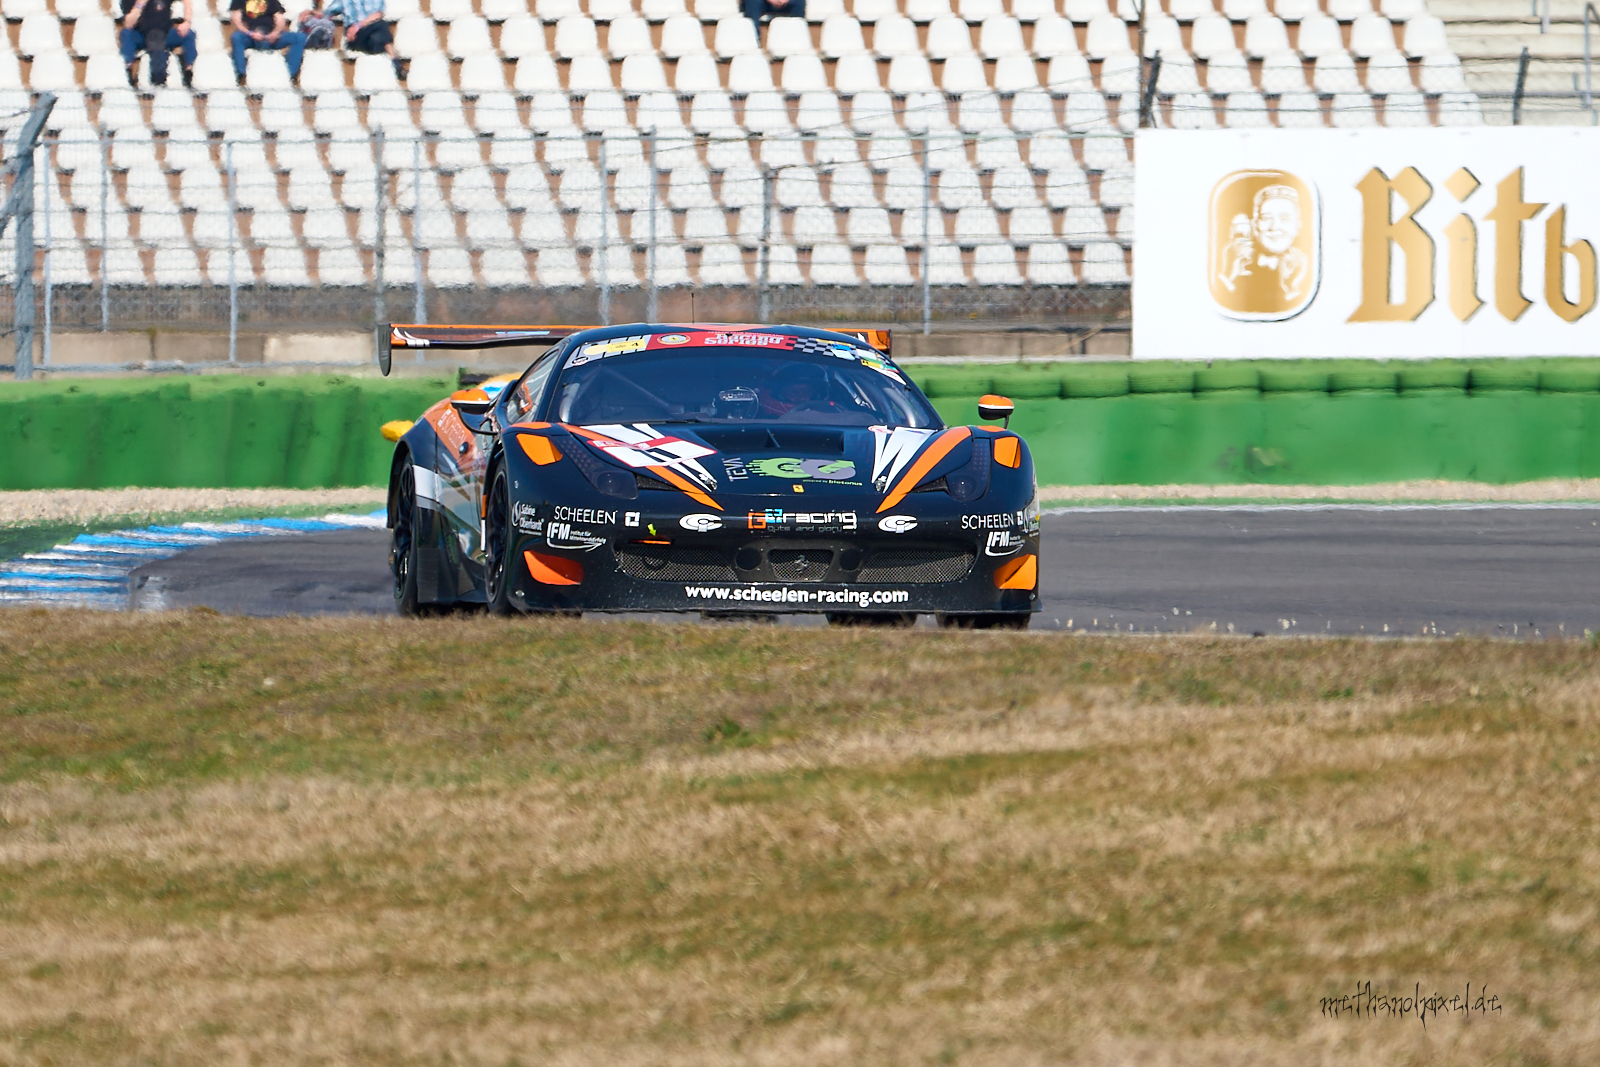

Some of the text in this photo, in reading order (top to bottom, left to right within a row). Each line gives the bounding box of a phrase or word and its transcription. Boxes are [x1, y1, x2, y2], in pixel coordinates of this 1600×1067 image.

[1346, 164, 1598, 324] Bitb
[521, 503, 536, 517] Sabine
[553, 505, 616, 525] SCHEELEN
[961, 512, 1015, 530] SCHEELEN
[547, 522, 571, 541] IFM
[986, 531, 1011, 547] IFM
[684, 585, 909, 608] www.scheelen-racing.com
